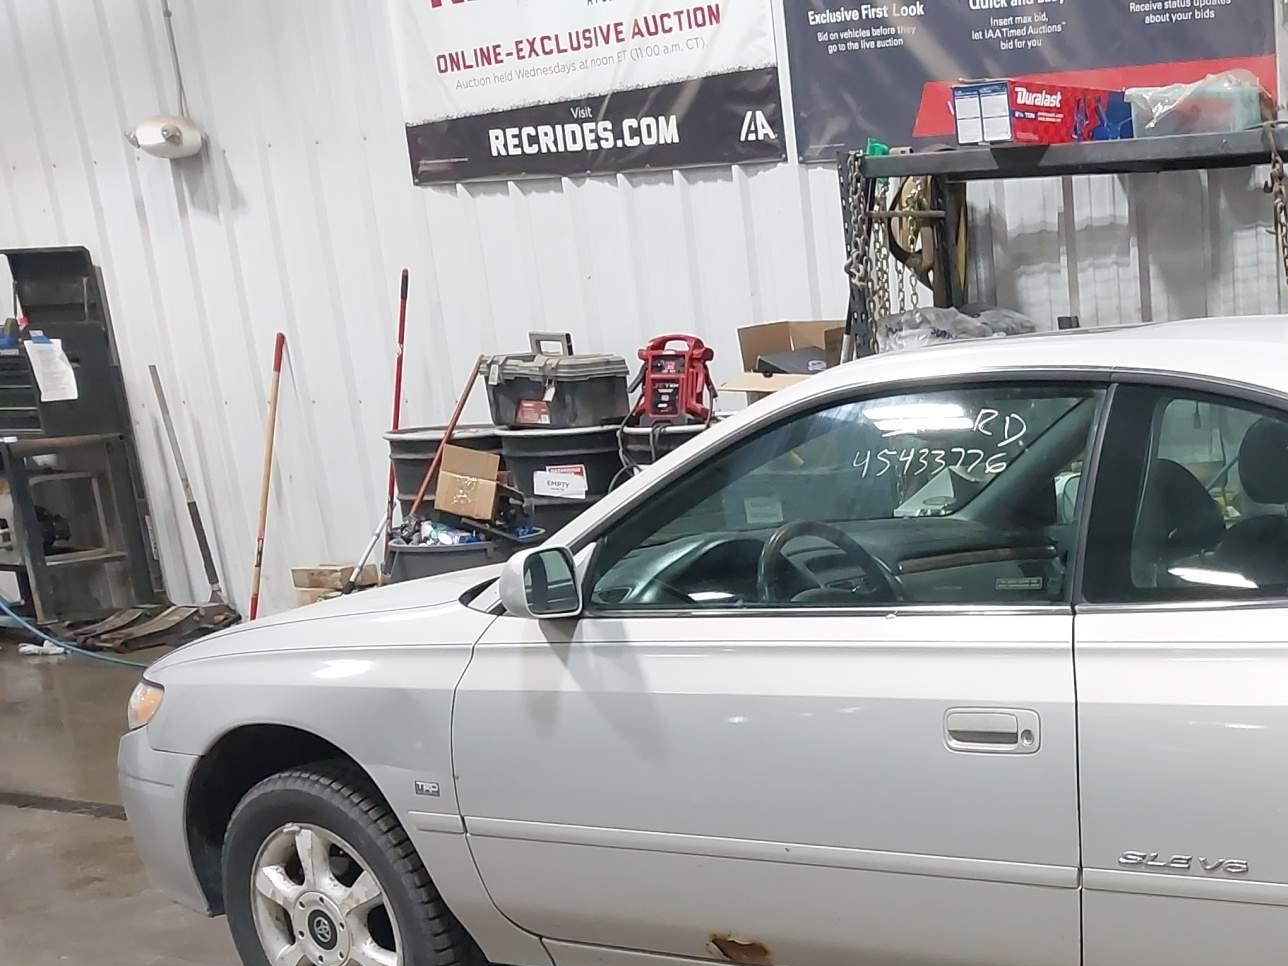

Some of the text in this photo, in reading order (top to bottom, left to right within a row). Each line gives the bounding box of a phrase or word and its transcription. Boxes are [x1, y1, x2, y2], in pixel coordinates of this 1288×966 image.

[808, 0, 925, 25] Exclusive First Look
[1129, 2, 1162, 12] Receive
[1164, 0, 1191, 9] status
[990, 11, 1048, 26] Insert max bid,
[1145, 8, 1215, 24] about your bids
[436, 3, 721, 74] ONLINE-EXCLUSIVE AUCTION
[817, 31, 828, 42] Bid
[829, 32, 839, 40] on
[839, 28, 870, 39] vehicles
[871, 26, 895, 36] before
[971, 30, 983, 40] let
[984, 29, 1001, 39] IAA
[1001, 26, 1026, 37] Timed
[827, 37, 904, 54] go to the live auction
[1000, 39, 1042, 50] bid for you
[455, 75, 491, 90] Auction
[493, 71, 513, 85] held
[515, 60, 577, 80] Wednesdays
[579, 59, 589, 71] at
[590, 54, 615, 67] noon
[617, 50, 627, 63] ET
[685, 37, 705, 50] CT)
[1015, 86, 1062, 108] Duralast
[570, 106, 593, 119] Visit
[488, 115, 680, 156] RECRIDES.COM
[852, 447, 1008, 479] 45433776
[546, 479, 570, 488] EMPTY
[1198, 856, 1249, 873] V6
